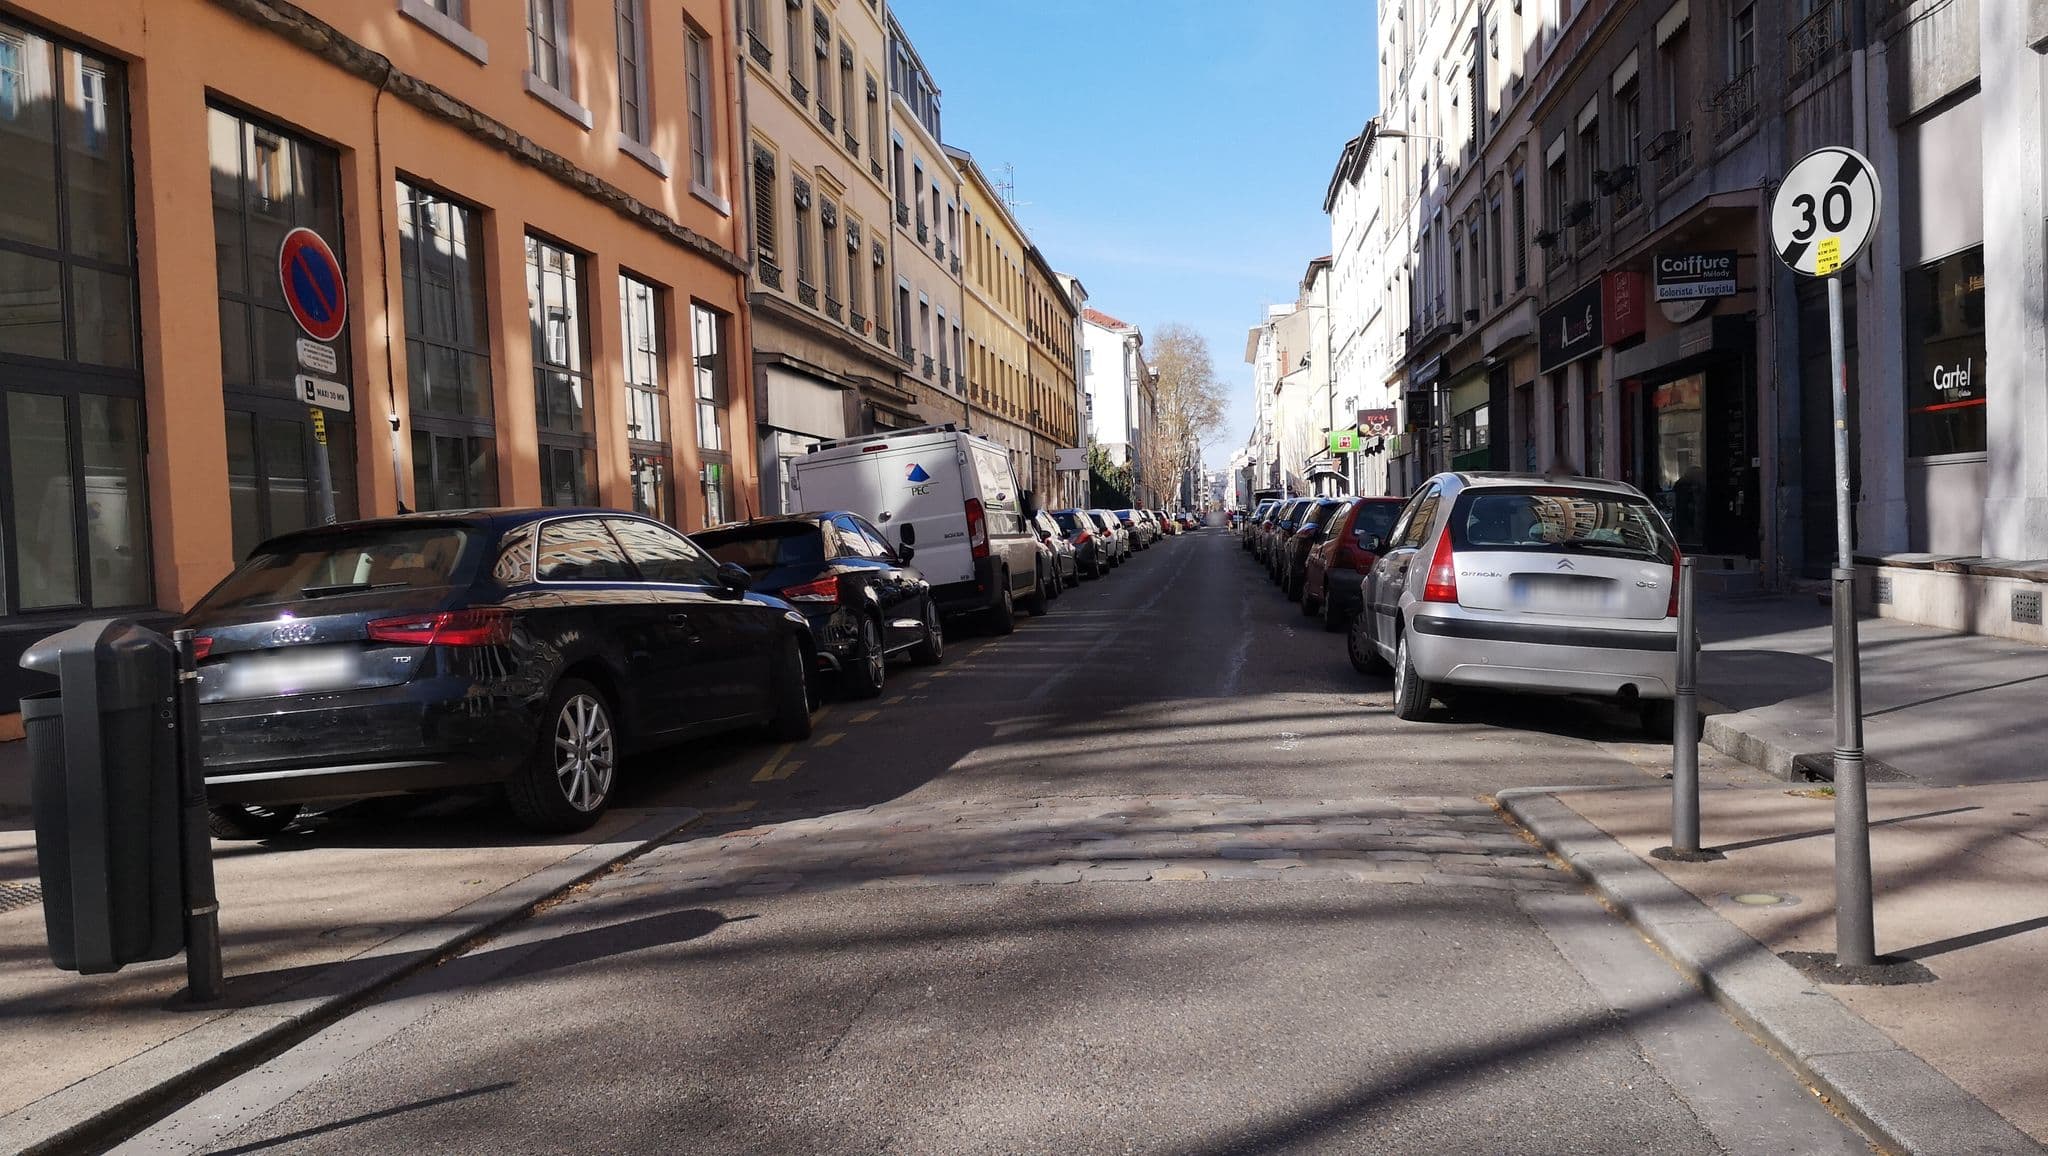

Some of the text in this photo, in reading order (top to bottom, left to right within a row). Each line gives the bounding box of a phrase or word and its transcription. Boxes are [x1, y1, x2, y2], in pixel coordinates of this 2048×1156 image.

[1792, 185, 1852, 241] 30
[1661, 255, 1730, 275] Coiffure
[1933, 357, 1972, 390] Cartel
[911, 486, 930, 496] PEC
